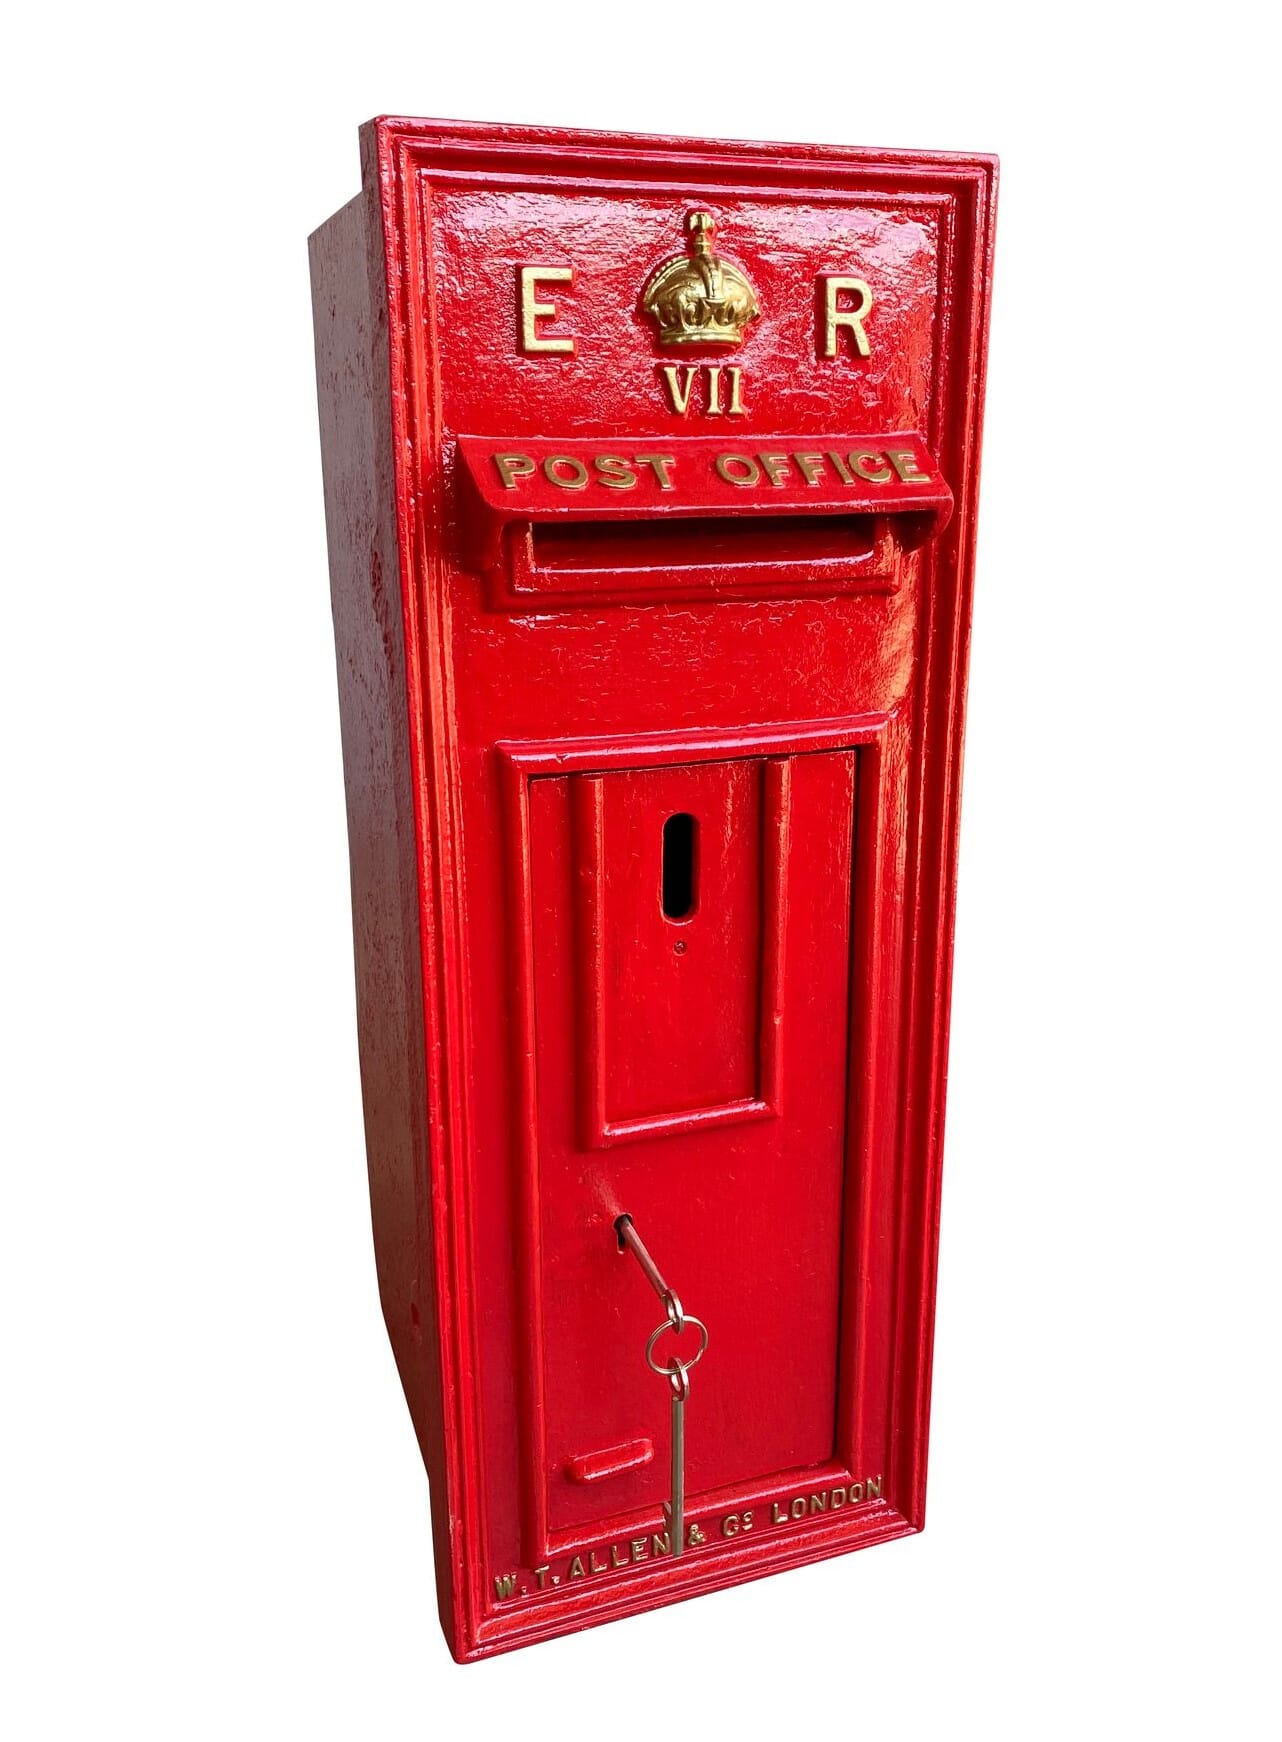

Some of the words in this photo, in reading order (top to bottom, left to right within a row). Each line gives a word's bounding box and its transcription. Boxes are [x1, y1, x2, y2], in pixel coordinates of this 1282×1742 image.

[520, 266, 577, 353] E
[823, 276, 875, 358] R
[662, 366, 745, 416] VII
[494, 452, 677, 490] POST
[714, 448, 931, 488] OFFICE
[687, 1522, 707, 1547] &
[773, 1474, 883, 1524] LONDON
